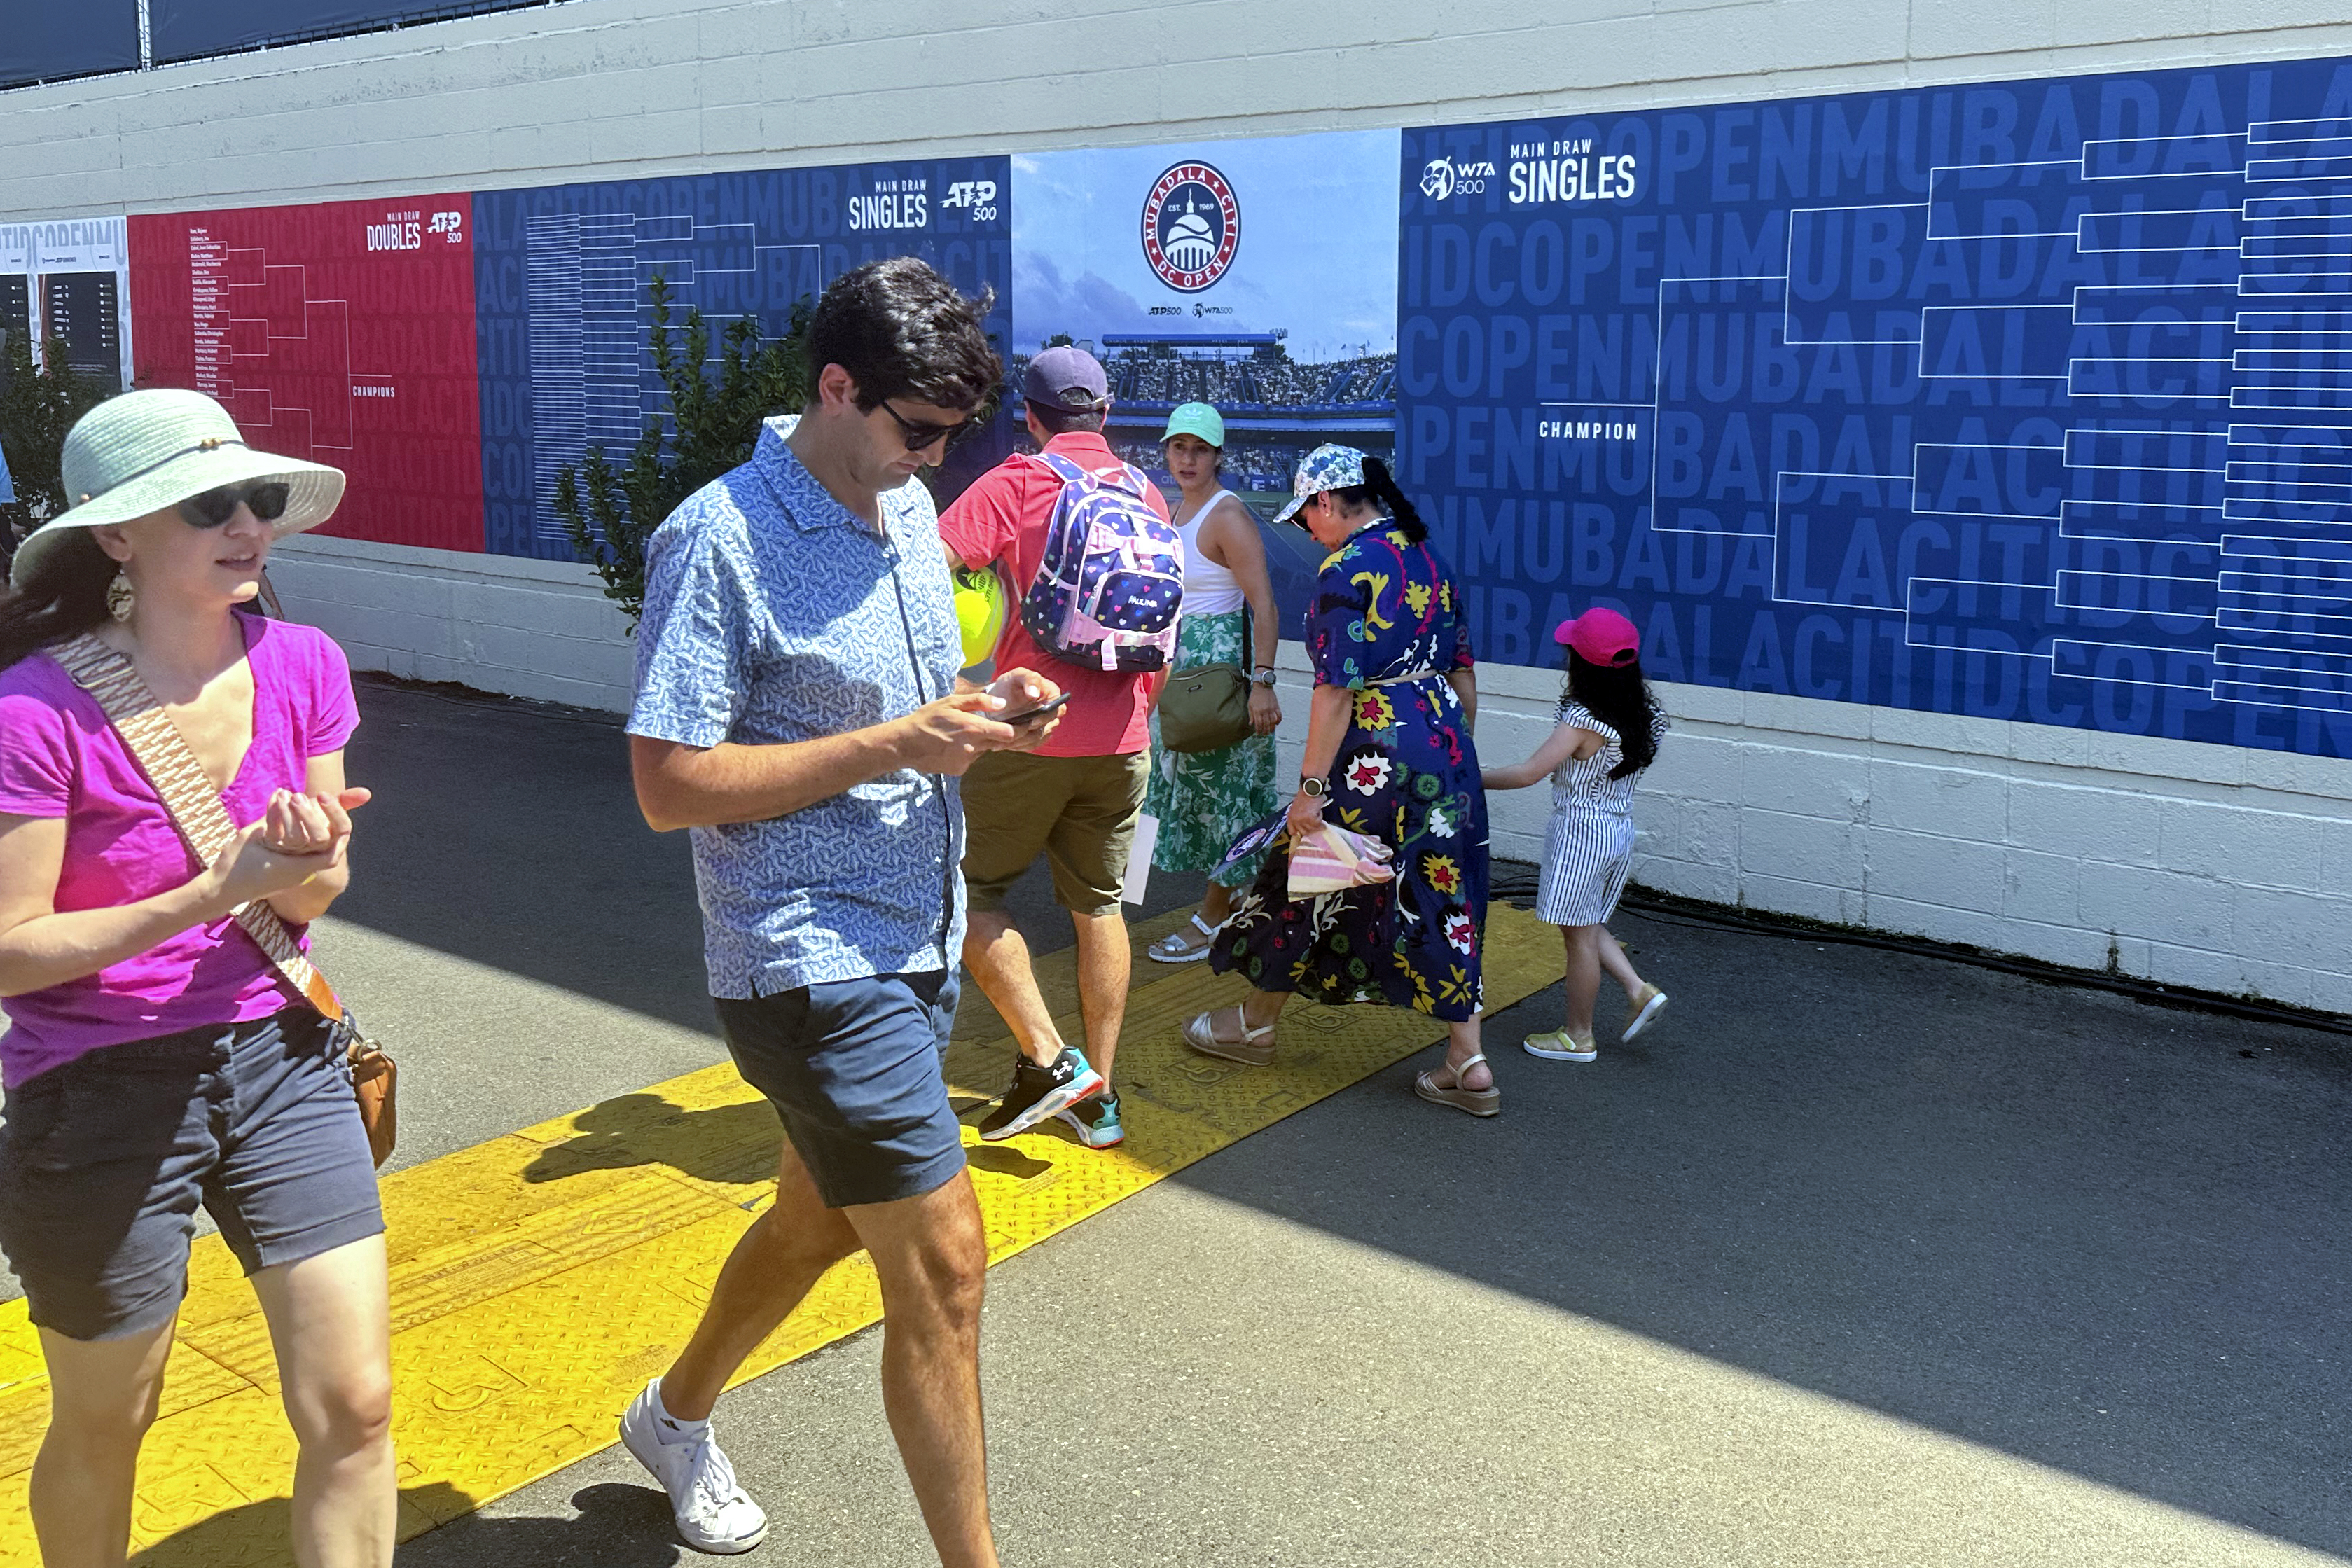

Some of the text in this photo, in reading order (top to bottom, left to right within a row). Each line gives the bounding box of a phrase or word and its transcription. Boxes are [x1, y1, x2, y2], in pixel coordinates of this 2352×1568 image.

[1510, 139, 1591, 158] MAIN DRAW
[1458, 162, 1495, 178] WTA
[1509, 155, 1635, 204] SINGLES
[876, 179, 927, 193] MAIN DRAW
[939, 181, 997, 208] ATP
[1455, 179, 1485, 195] 500
[849, 194, 927, 230] SINGLES
[1146, 167, 1206, 240] MUBADALA
[387, 211, 420, 222] MAIN DRAW
[427, 211, 462, 234] ATP
[973, 207, 997, 221] 500
[1221, 195, 1236, 237] CITI
[367, 223, 420, 251] DOUBLES
[447, 233, 462, 243] 500
[1158, 258, 1224, 286] DC OPEN
[352, 385, 395, 398] CHAMPIONS
[1539, 421, 1636, 440] CHAMPION
